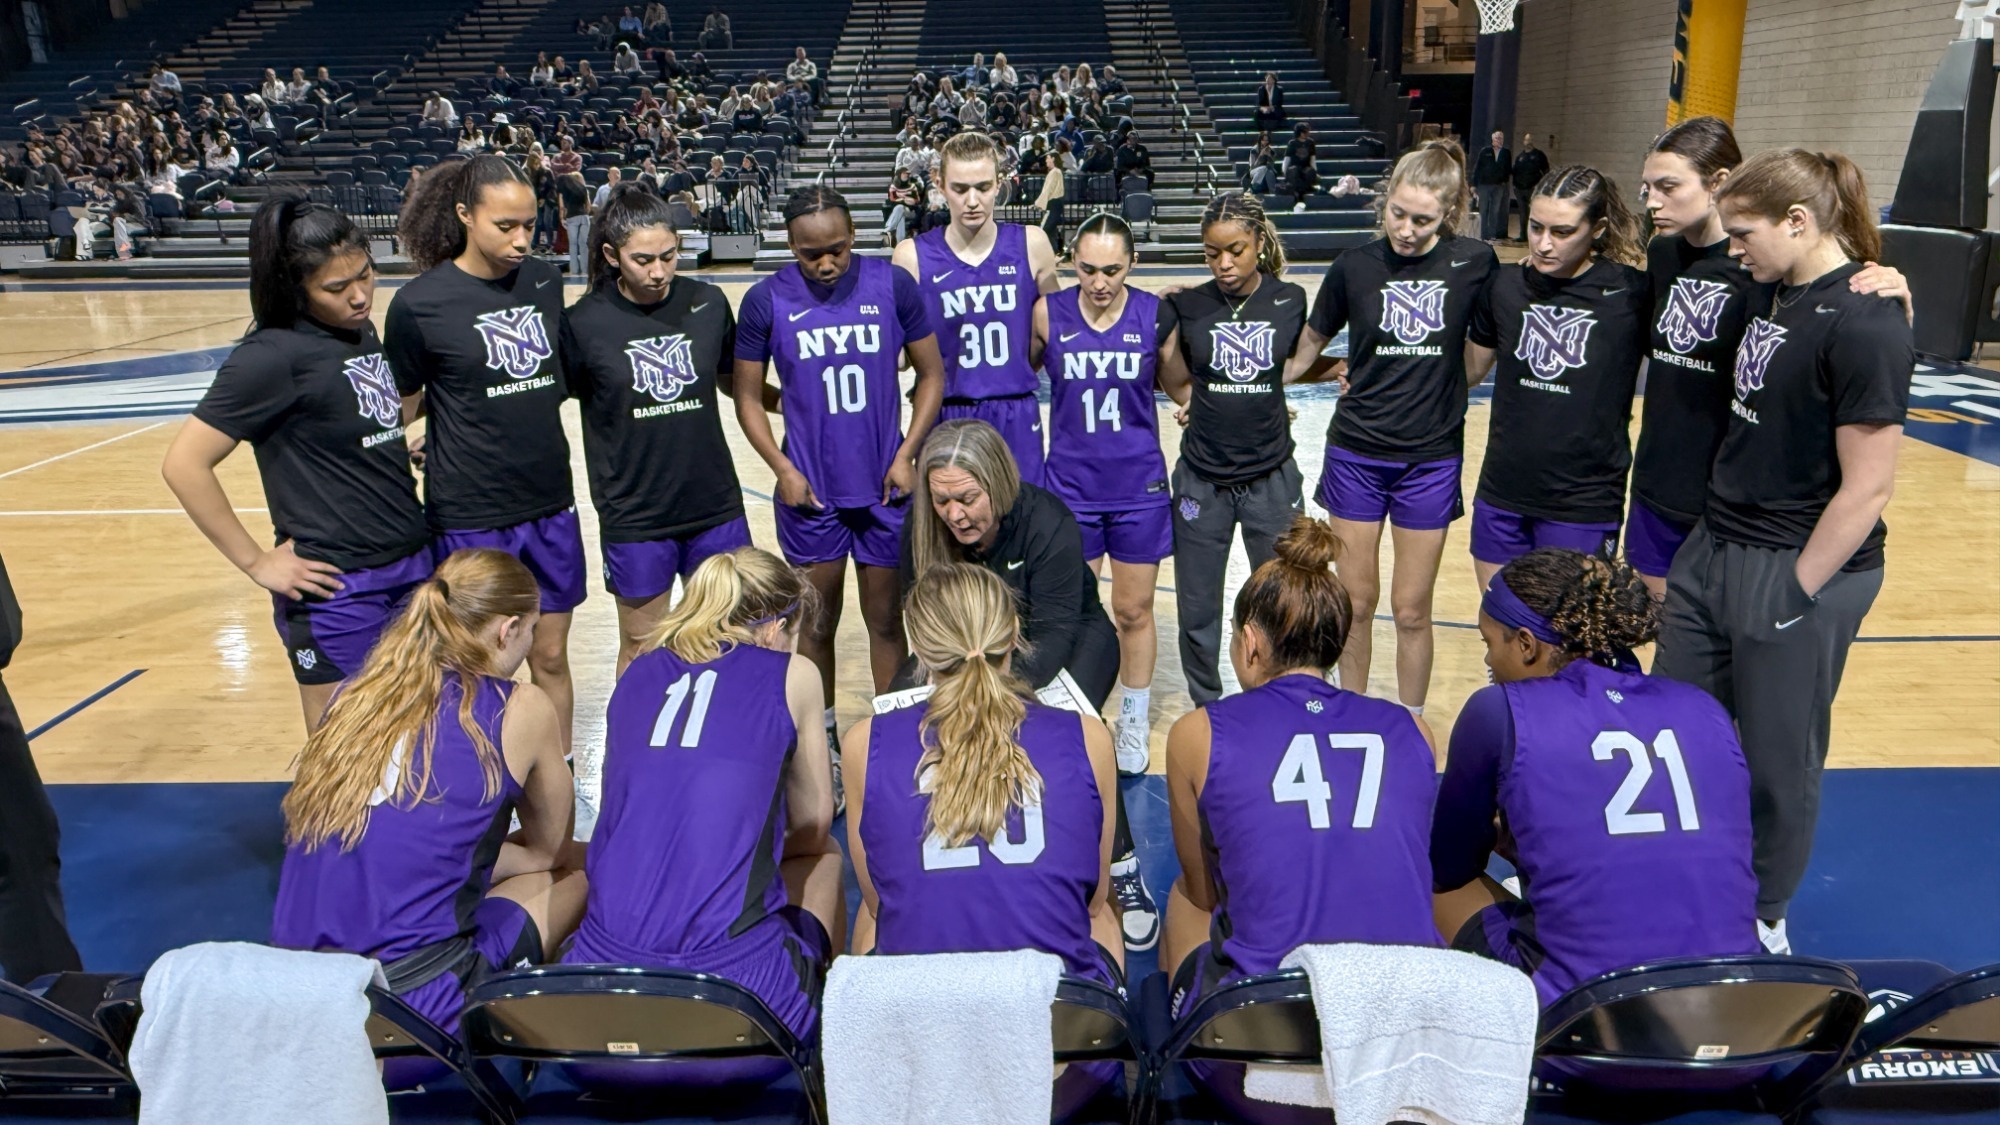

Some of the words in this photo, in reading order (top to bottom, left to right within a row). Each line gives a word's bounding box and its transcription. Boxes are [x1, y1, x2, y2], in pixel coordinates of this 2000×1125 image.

[940, 284, 1017, 319] NYU
[796, 324, 880, 360] NYU
[958, 321, 1010, 369] 30
[1376, 345, 1443, 356] BASKETBALL
[1063, 351, 1141, 380] NYU
[1653, 348, 1716, 373] BASKETBALL
[486, 374, 556, 398] BASKETBALL
[822, 364, 867, 415] 10
[1207, 382, 1273, 394] BASKETBALL
[1519, 378, 1571, 395] BASKETBALL
[633, 398, 704, 419] BASKETBALL
[1081, 388, 1122, 434] 14
[649, 669, 719, 748] 11
[1272, 733, 1385, 829] 47
[1591, 729, 1700, 835] 21
[1861, 1060, 1983, 1079] EMORY
